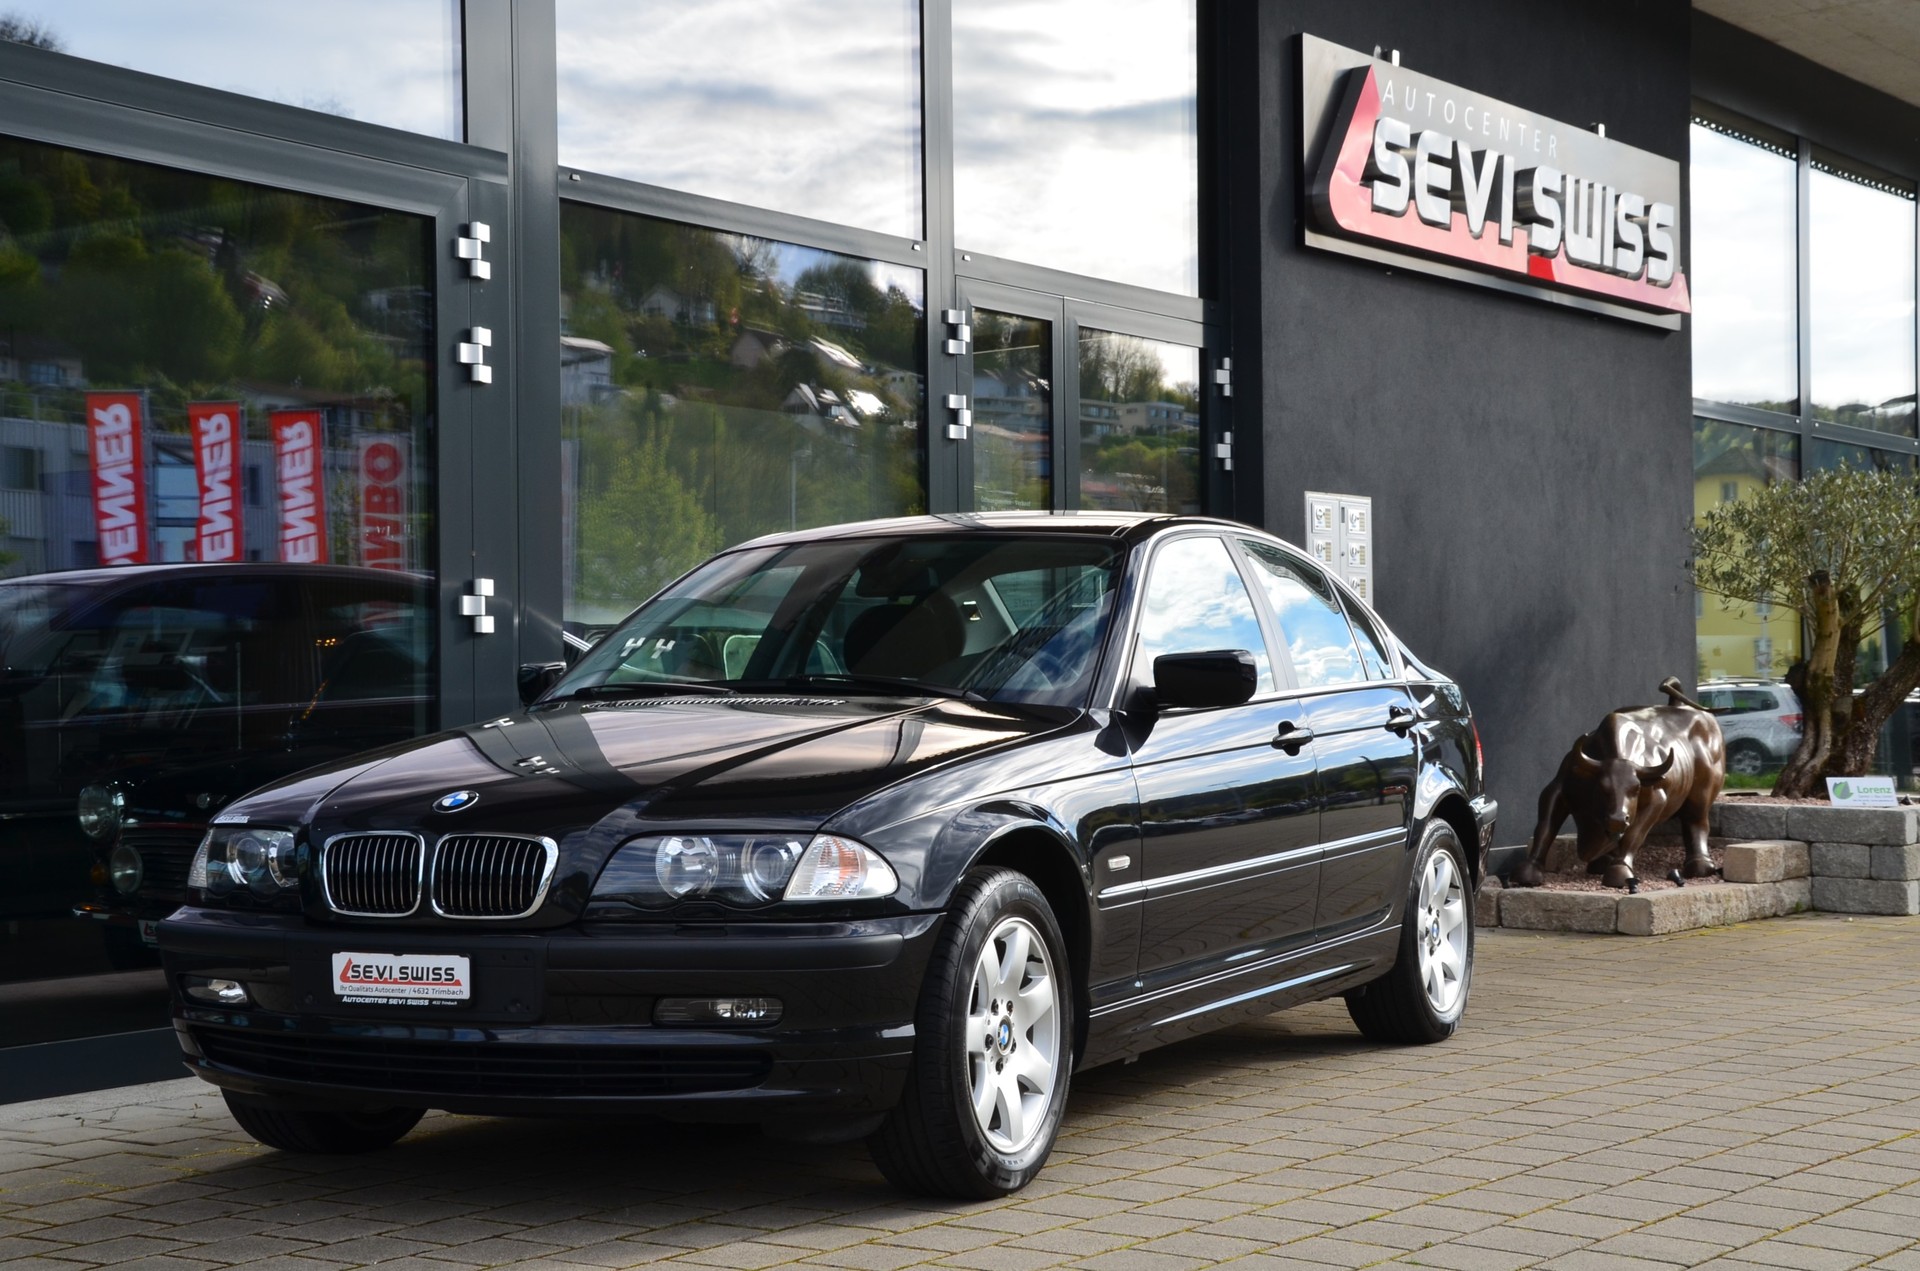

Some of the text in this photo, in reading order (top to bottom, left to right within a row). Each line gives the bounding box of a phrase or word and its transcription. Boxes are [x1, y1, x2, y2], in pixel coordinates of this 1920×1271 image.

[1382, 79, 1558, 158] AUTOCENTER
[1372, 117, 1675, 284] SEVI SWISS
[1857, 786, 1892, 794] Lorenz
[350, 964, 455, 982] SEVI SWISS
[431, 988, 464, 996] Trimbach
